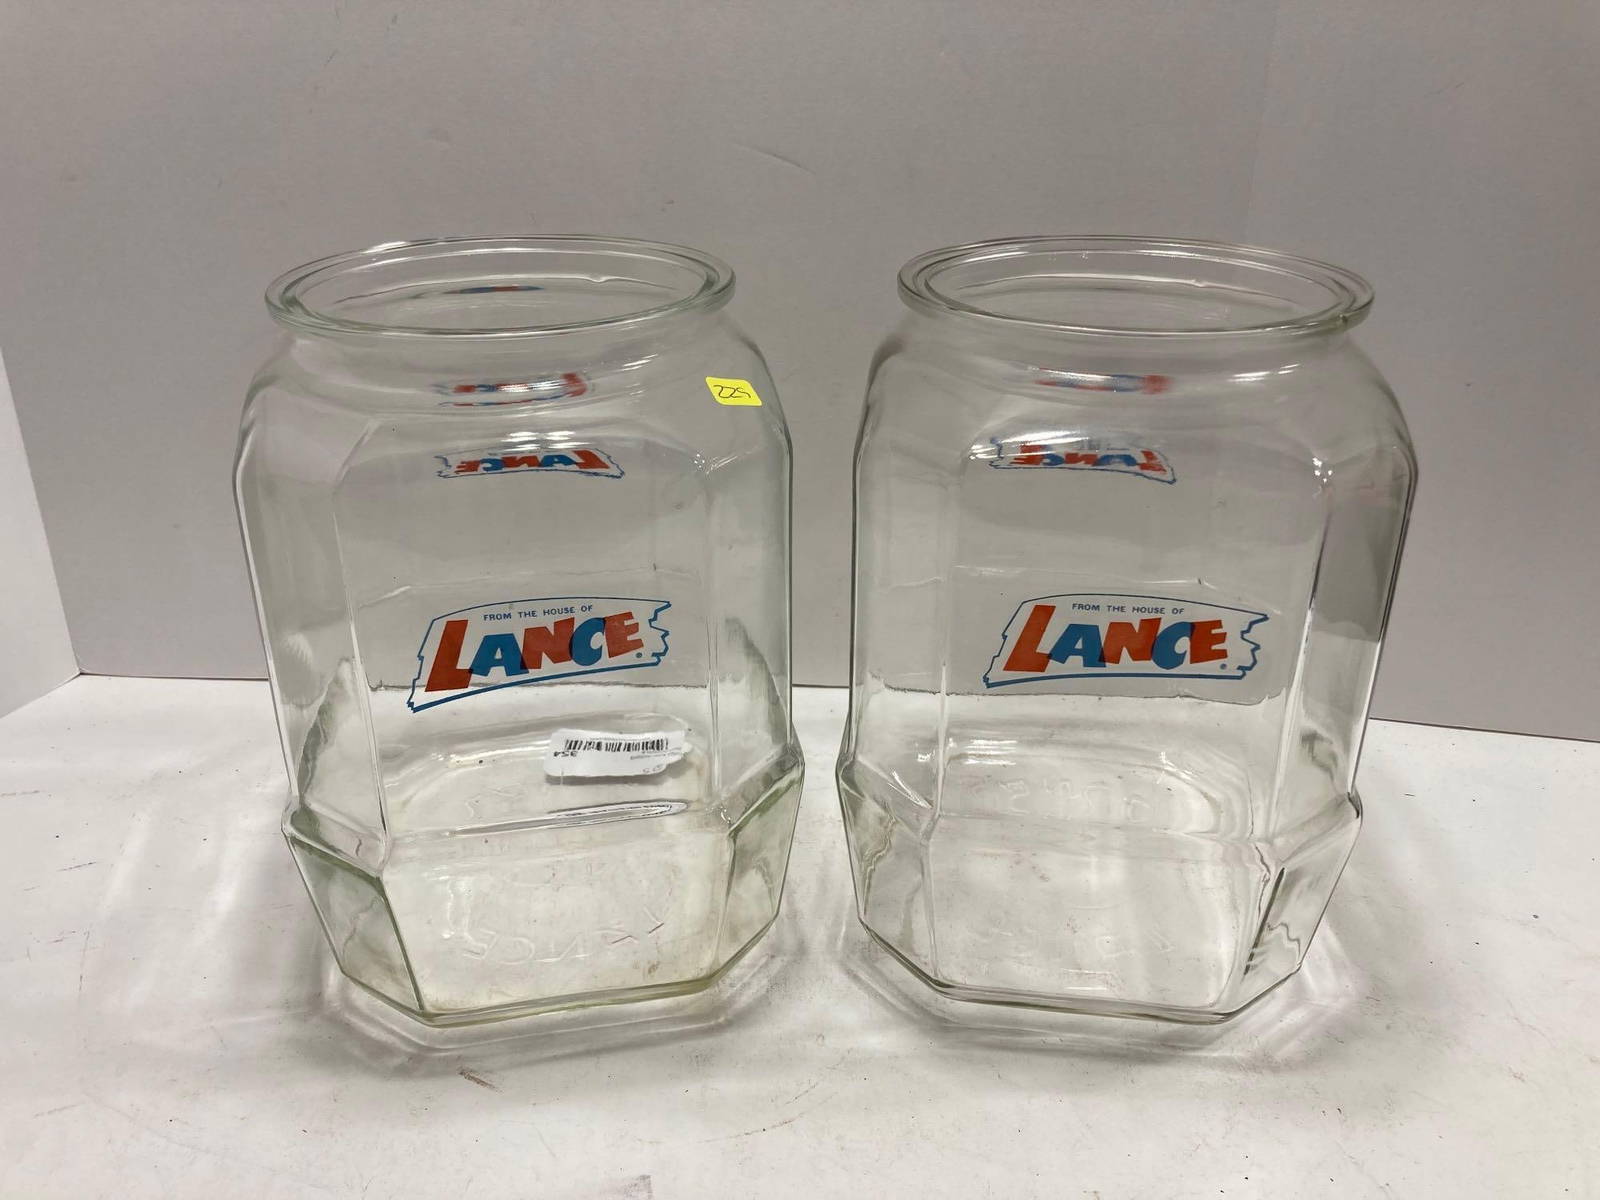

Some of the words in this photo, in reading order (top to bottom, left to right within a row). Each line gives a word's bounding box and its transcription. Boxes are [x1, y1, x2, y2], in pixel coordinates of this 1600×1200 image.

[483, 613, 512, 621] FROM
[518, 610, 537, 619] THE
[543, 606, 576, 616] HOUSE
[580, 604, 593, 613] OF
[1072, 602, 1101, 612] FROM
[1107, 604, 1126, 614] THE
[1132, 605, 1166, 615] HOUSE
[1171, 607, 1185, 615] OF
[424, 611, 644, 692] LANCE
[1002, 604, 1228, 673] LANCE
